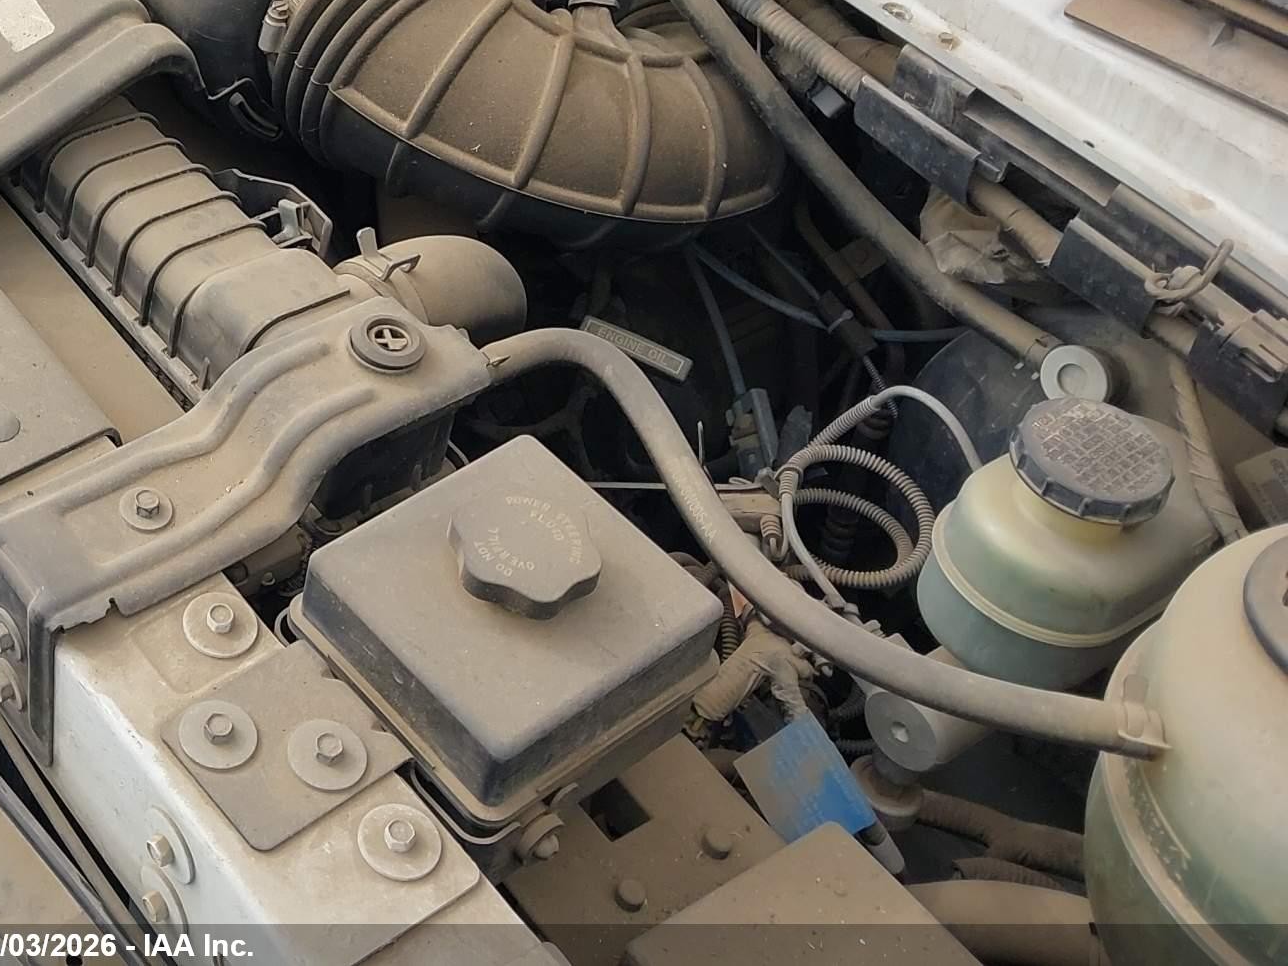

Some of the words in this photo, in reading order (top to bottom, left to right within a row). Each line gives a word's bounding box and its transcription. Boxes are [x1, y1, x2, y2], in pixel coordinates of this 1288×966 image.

[598, 327, 643, 354] ENGINE
[647, 348, 668, 366] OIL
[505, 495, 552, 512] POWER
[555, 512, 584, 565] STEERING
[530, 509, 565, 542] FLUID
[473, 541, 496, 562] NOT
[487, 526, 536, 571] OVERFILL
[495, 562, 513, 577] DO
